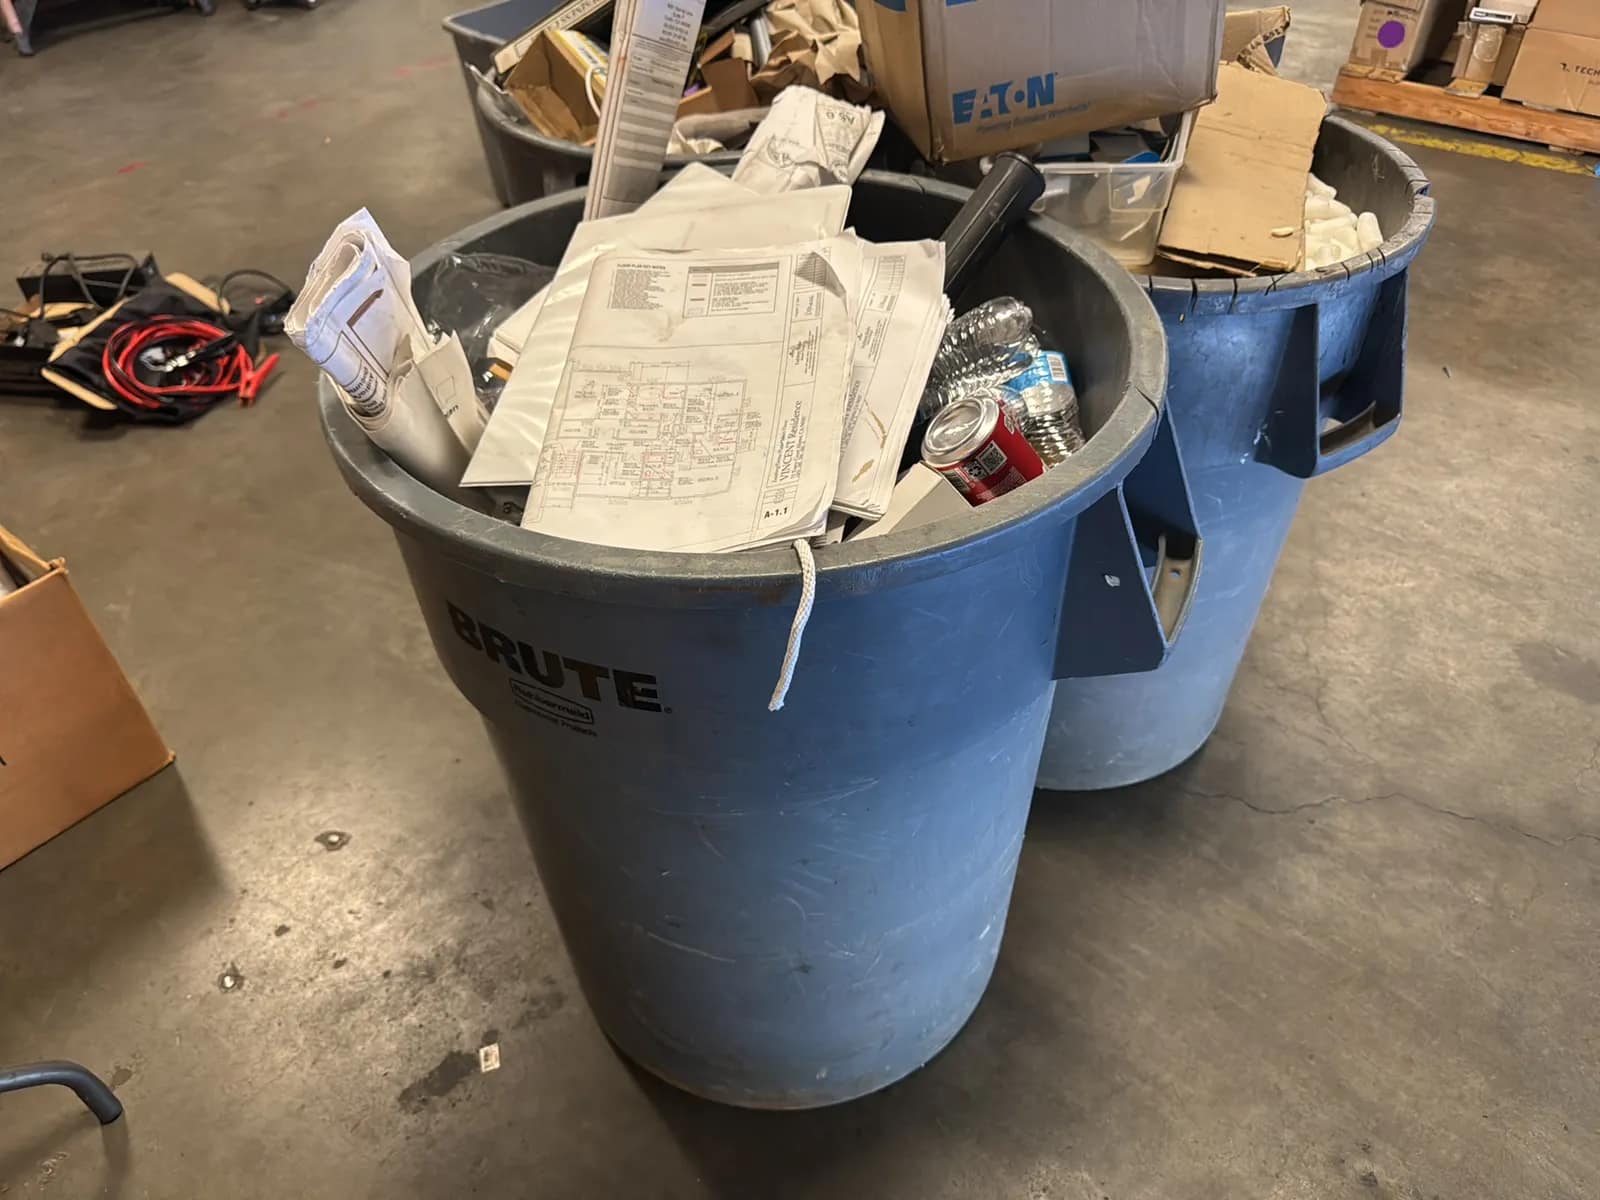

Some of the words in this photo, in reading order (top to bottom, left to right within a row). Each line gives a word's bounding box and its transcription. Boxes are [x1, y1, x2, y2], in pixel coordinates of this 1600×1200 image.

[952, 72, 1056, 125] EATON
[786, 400, 803, 439] Residence
[780, 440, 795, 482] VINCENT
[447, 599, 663, 713] BRUTE
